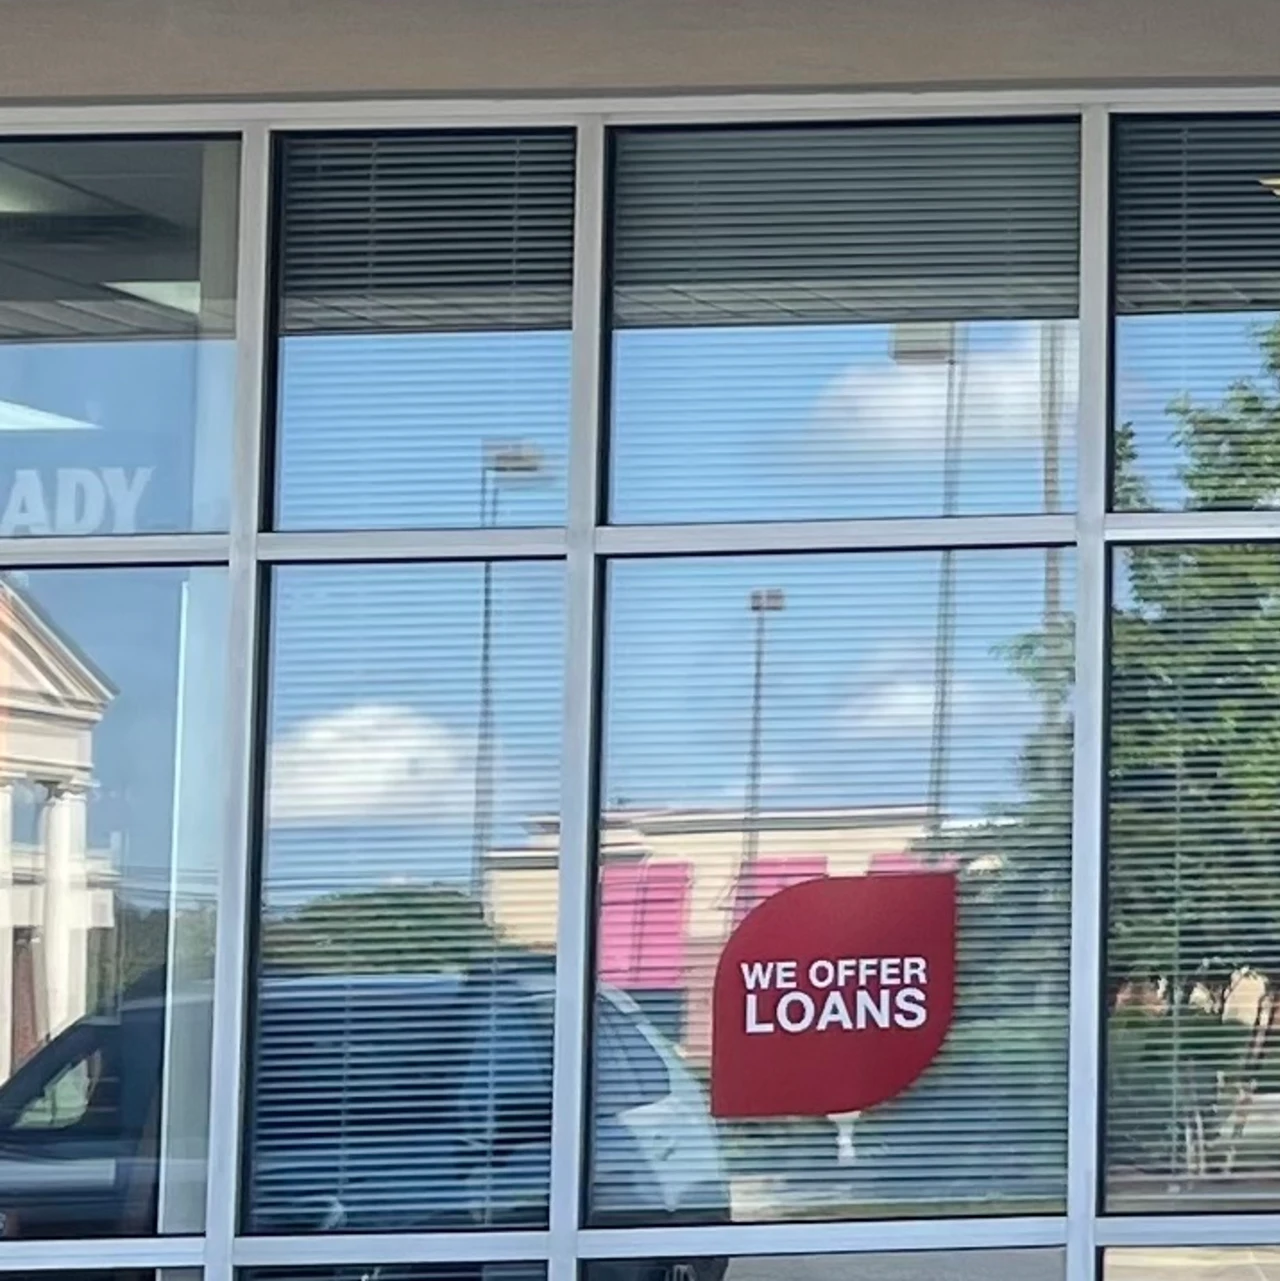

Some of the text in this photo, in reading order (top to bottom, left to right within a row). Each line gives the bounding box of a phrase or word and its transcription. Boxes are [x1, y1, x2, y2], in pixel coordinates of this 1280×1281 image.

[740, 956, 928, 990] WE OFFER
[745, 987, 928, 1034] LOANS
